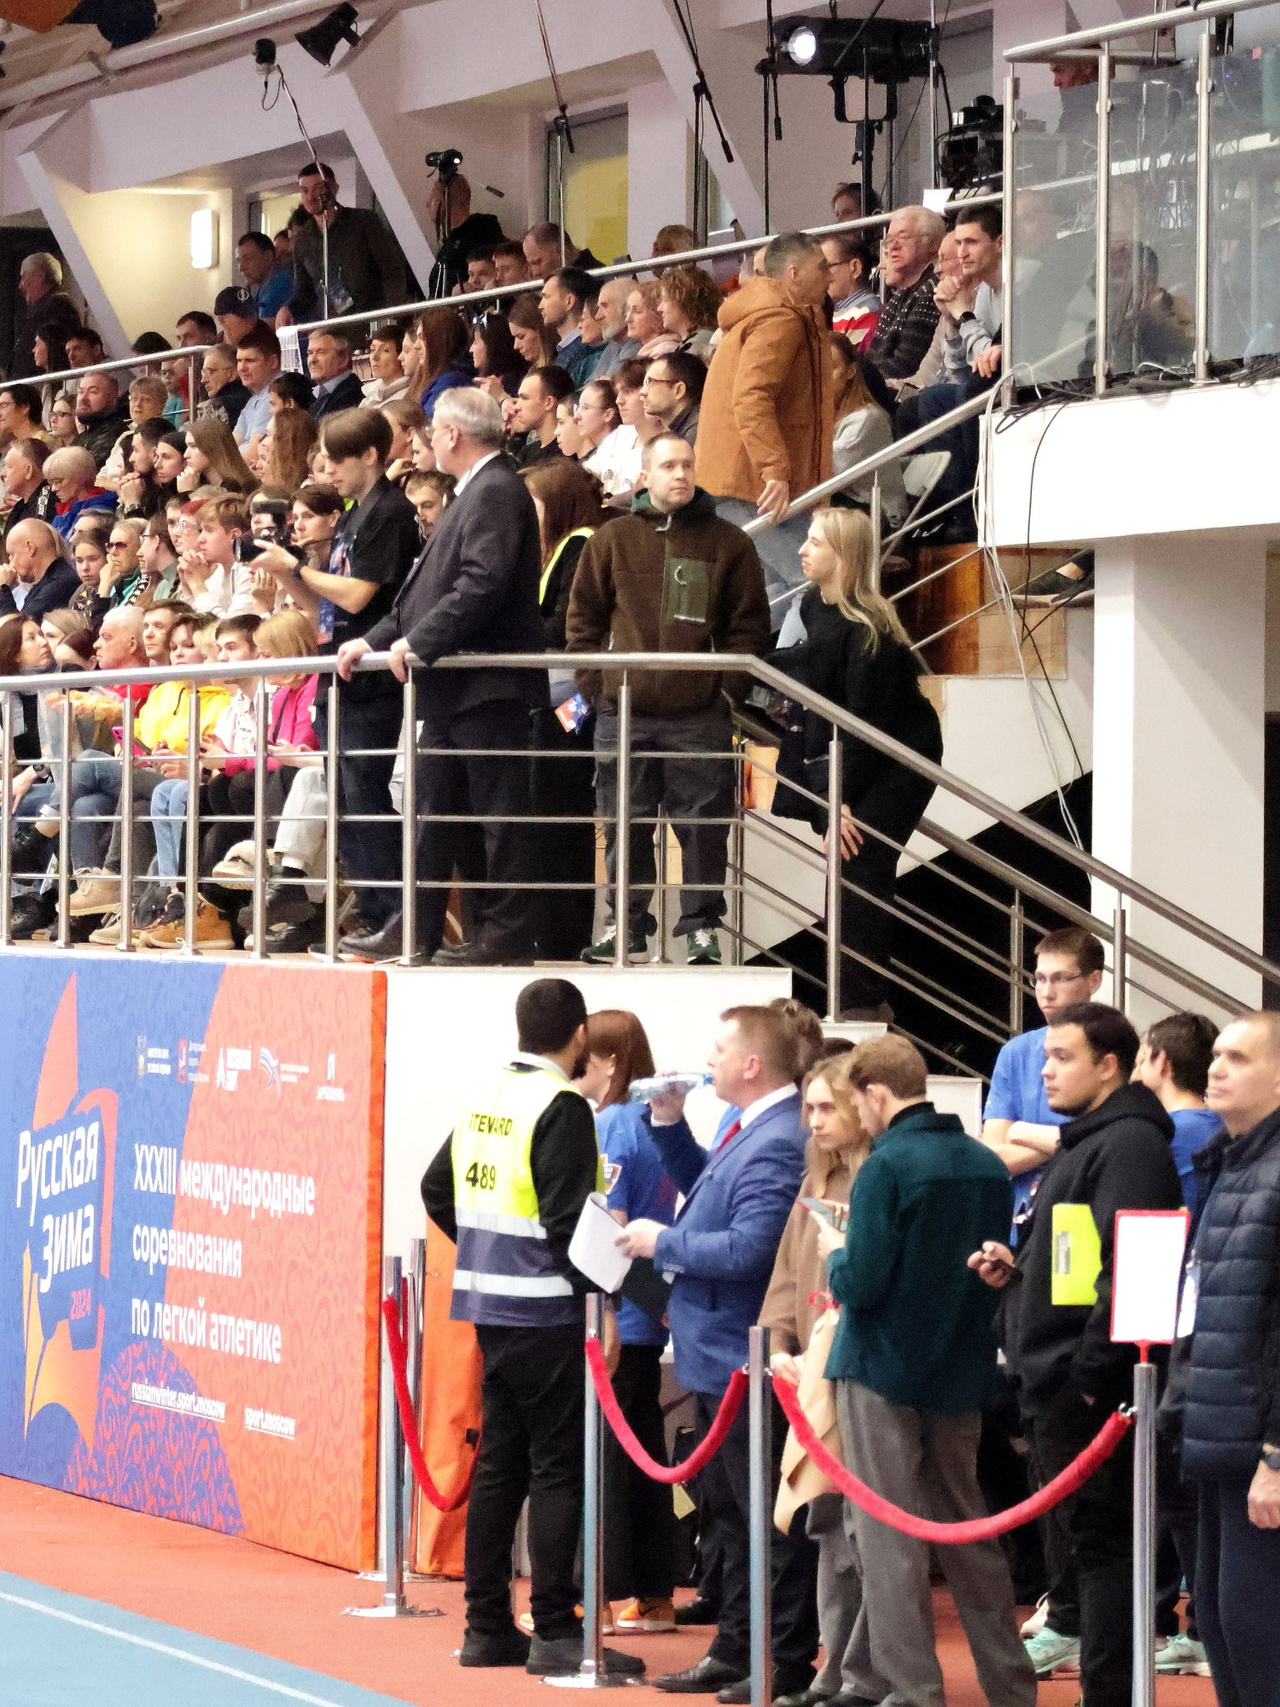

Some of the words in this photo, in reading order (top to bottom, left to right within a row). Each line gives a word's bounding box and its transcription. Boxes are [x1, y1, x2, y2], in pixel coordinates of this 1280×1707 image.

[16, 1121, 99, 1228] Русская
[134, 1143, 177, 1195] XXXIII
[180, 1159, 315, 1220] международные
[465, 1161, 496, 1191] 489
[39, 1204, 94, 1294] Зима
[132, 1224, 243, 1279] соревнования
[70, 1288, 92, 1320] 2024
[131, 1298, 150, 1337] по
[152, 1296, 206, 1348] легкой
[209, 1312, 282, 1364] атлетике
[244, 1407, 296, 1437] sport.moscow
